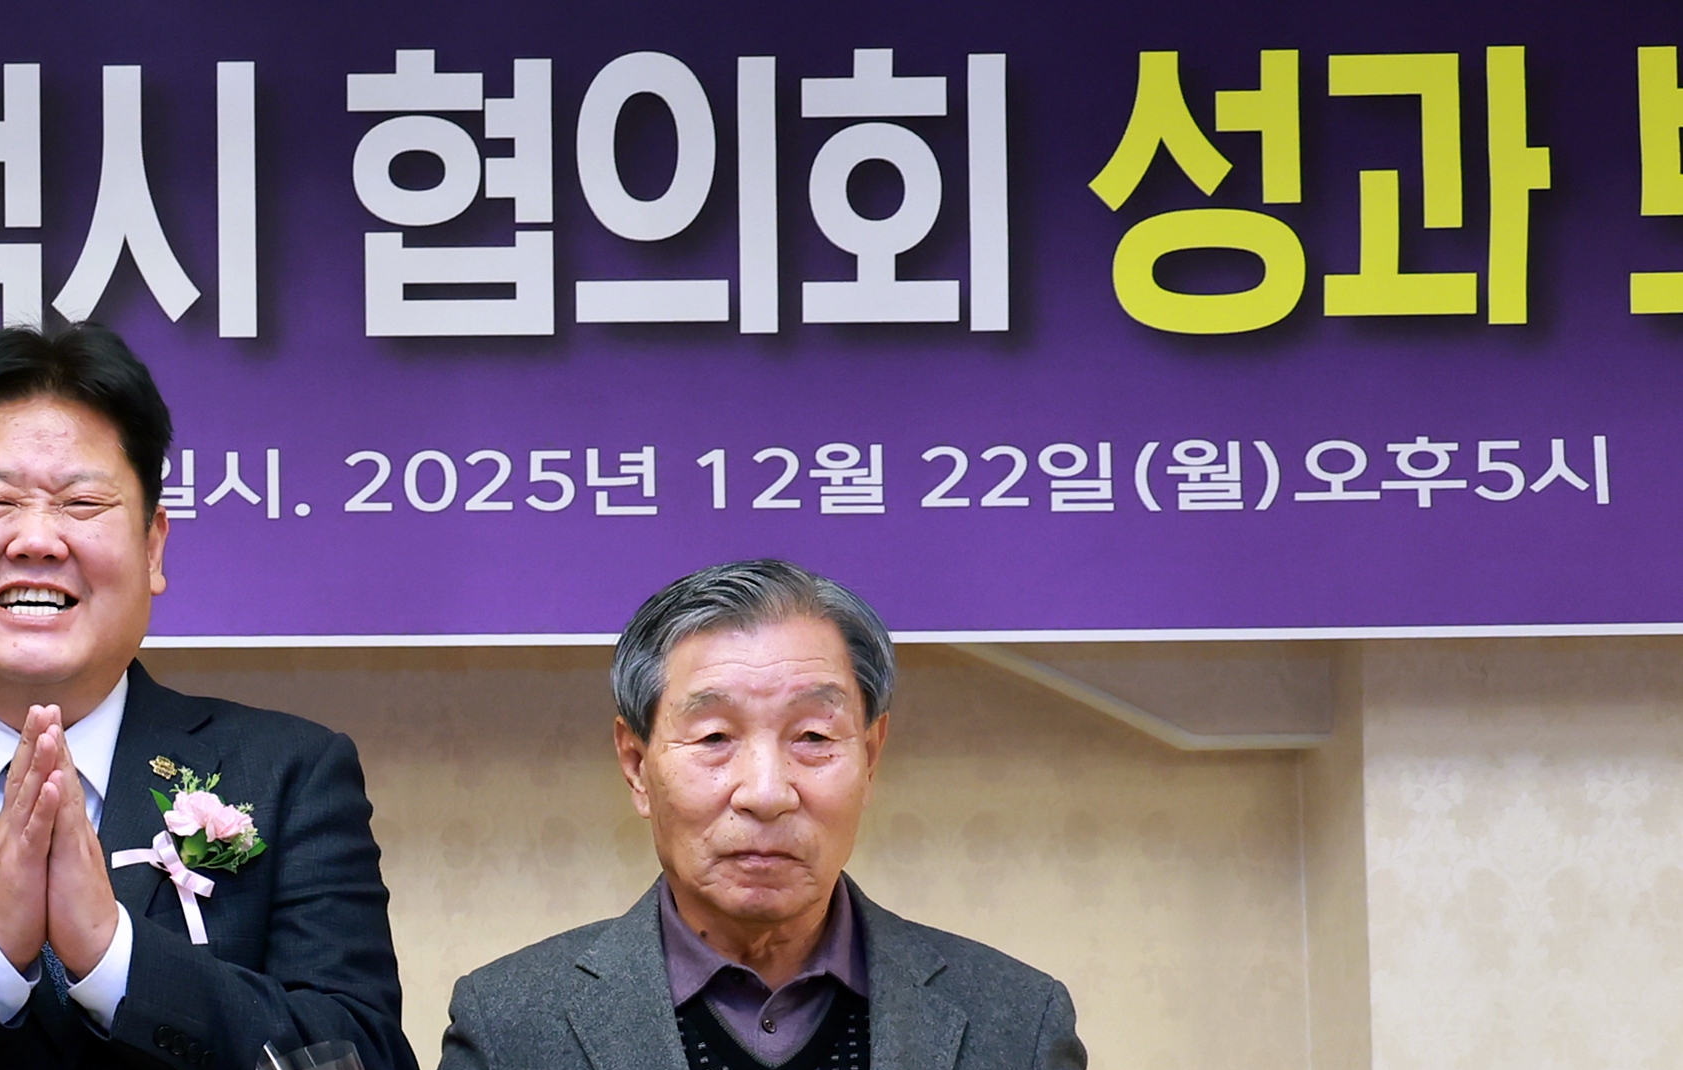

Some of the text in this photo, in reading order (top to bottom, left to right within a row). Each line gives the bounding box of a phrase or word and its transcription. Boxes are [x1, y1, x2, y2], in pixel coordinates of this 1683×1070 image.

[346, 47, 1009, 337] 협의회
[1087, 45, 1550, 335] 성과
[344, 444, 660, 517] 2025년
[695, 443, 885, 516] 12월
